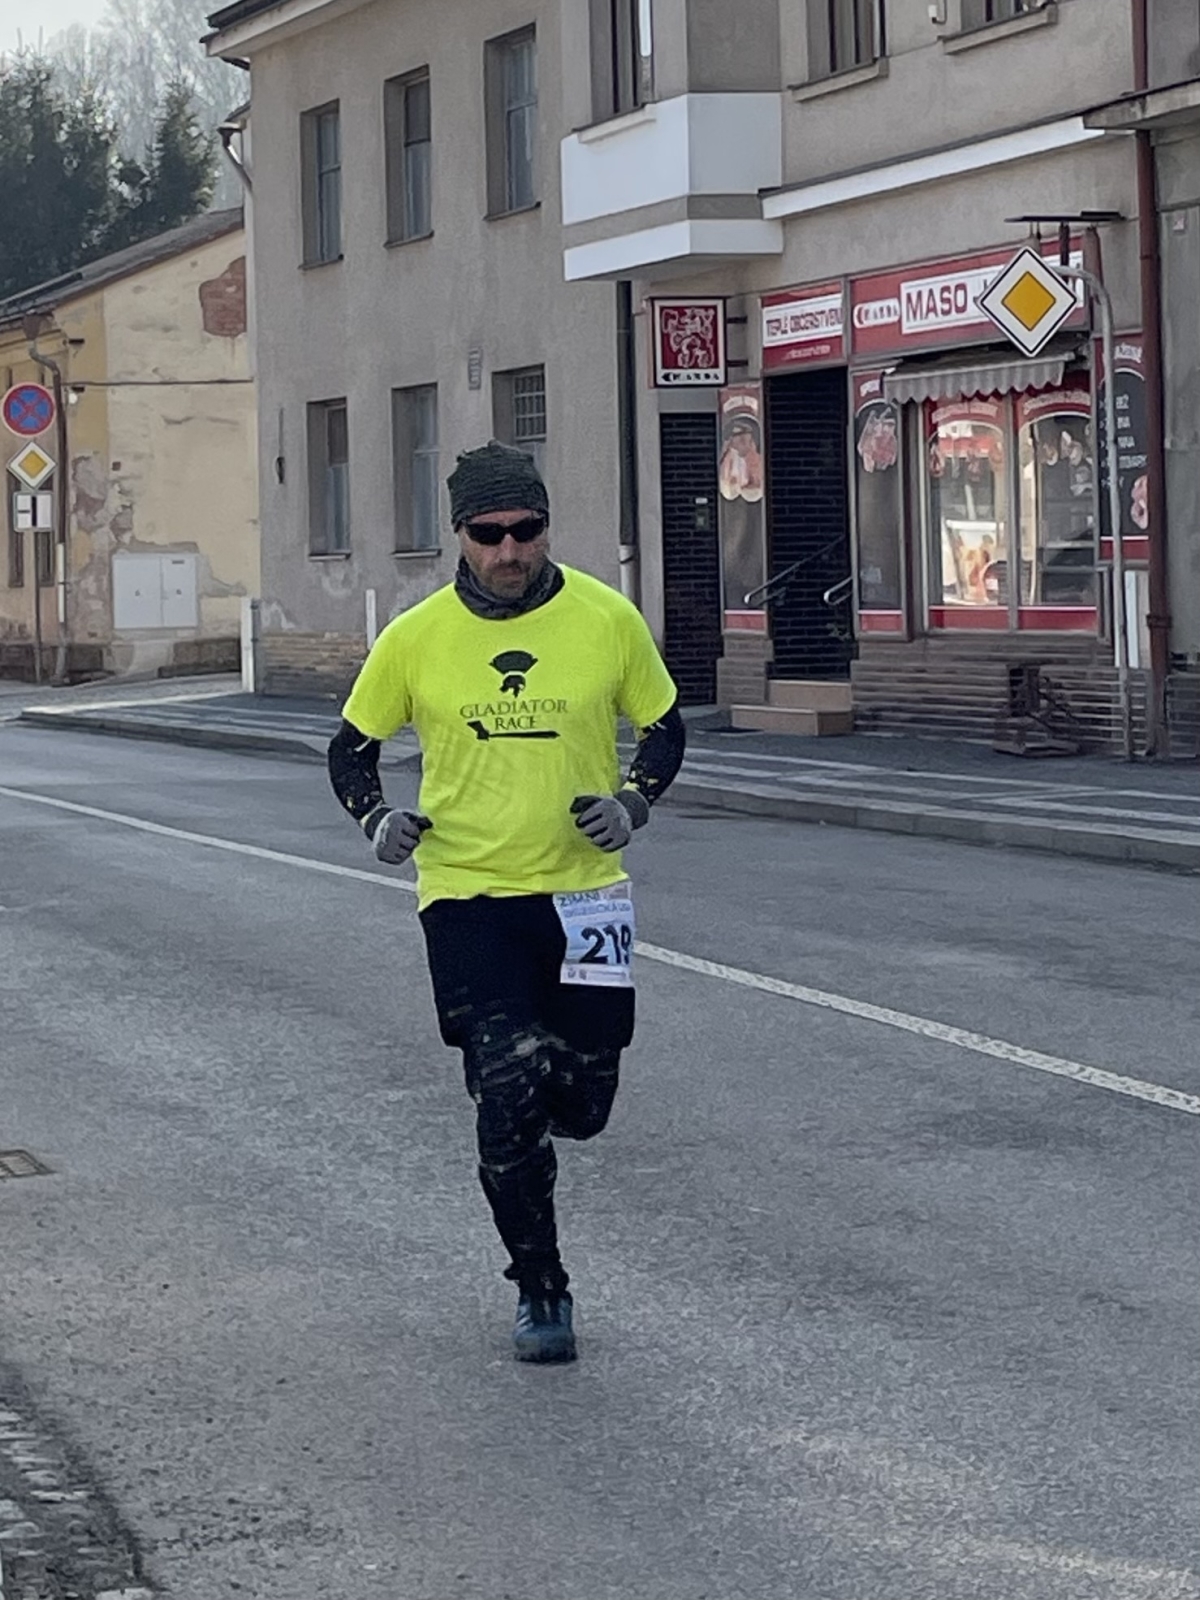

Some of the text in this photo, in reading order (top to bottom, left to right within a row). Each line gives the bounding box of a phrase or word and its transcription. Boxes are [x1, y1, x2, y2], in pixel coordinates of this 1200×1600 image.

[905, 282, 968, 323] MASO
[460, 699, 568, 719] GLADIATOR
[494, 715, 537, 730] RACE
